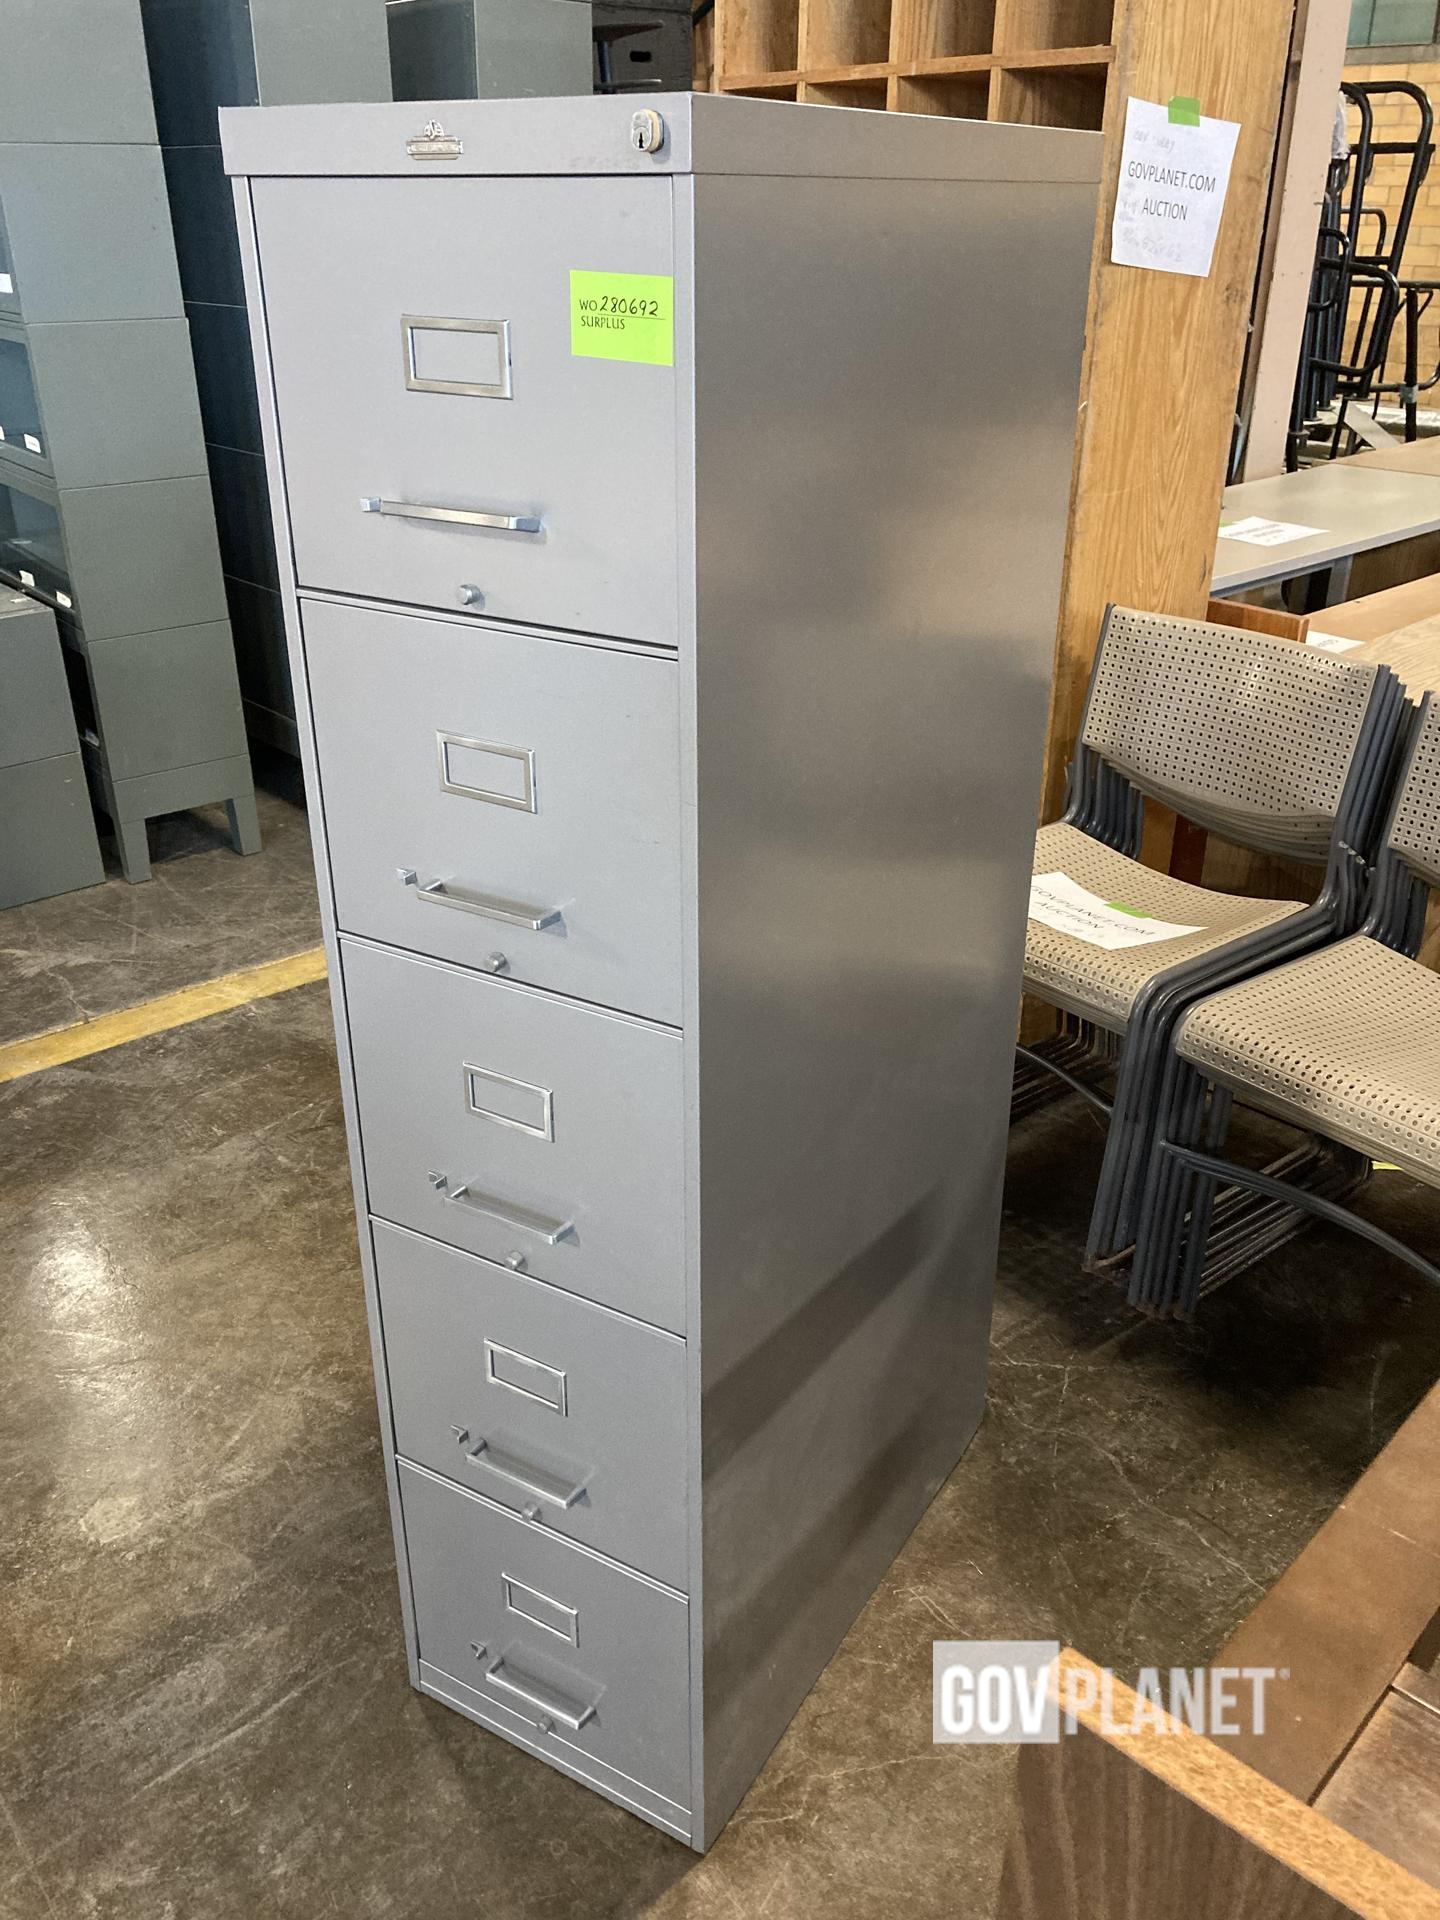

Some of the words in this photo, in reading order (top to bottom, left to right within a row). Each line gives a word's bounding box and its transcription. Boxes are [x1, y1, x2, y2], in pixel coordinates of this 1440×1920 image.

[1128, 160, 1216, 193] GOVPLANET.COM
[1143, 198, 1187, 221] AUCTION
[581, 315, 625, 329] SURPLUS
